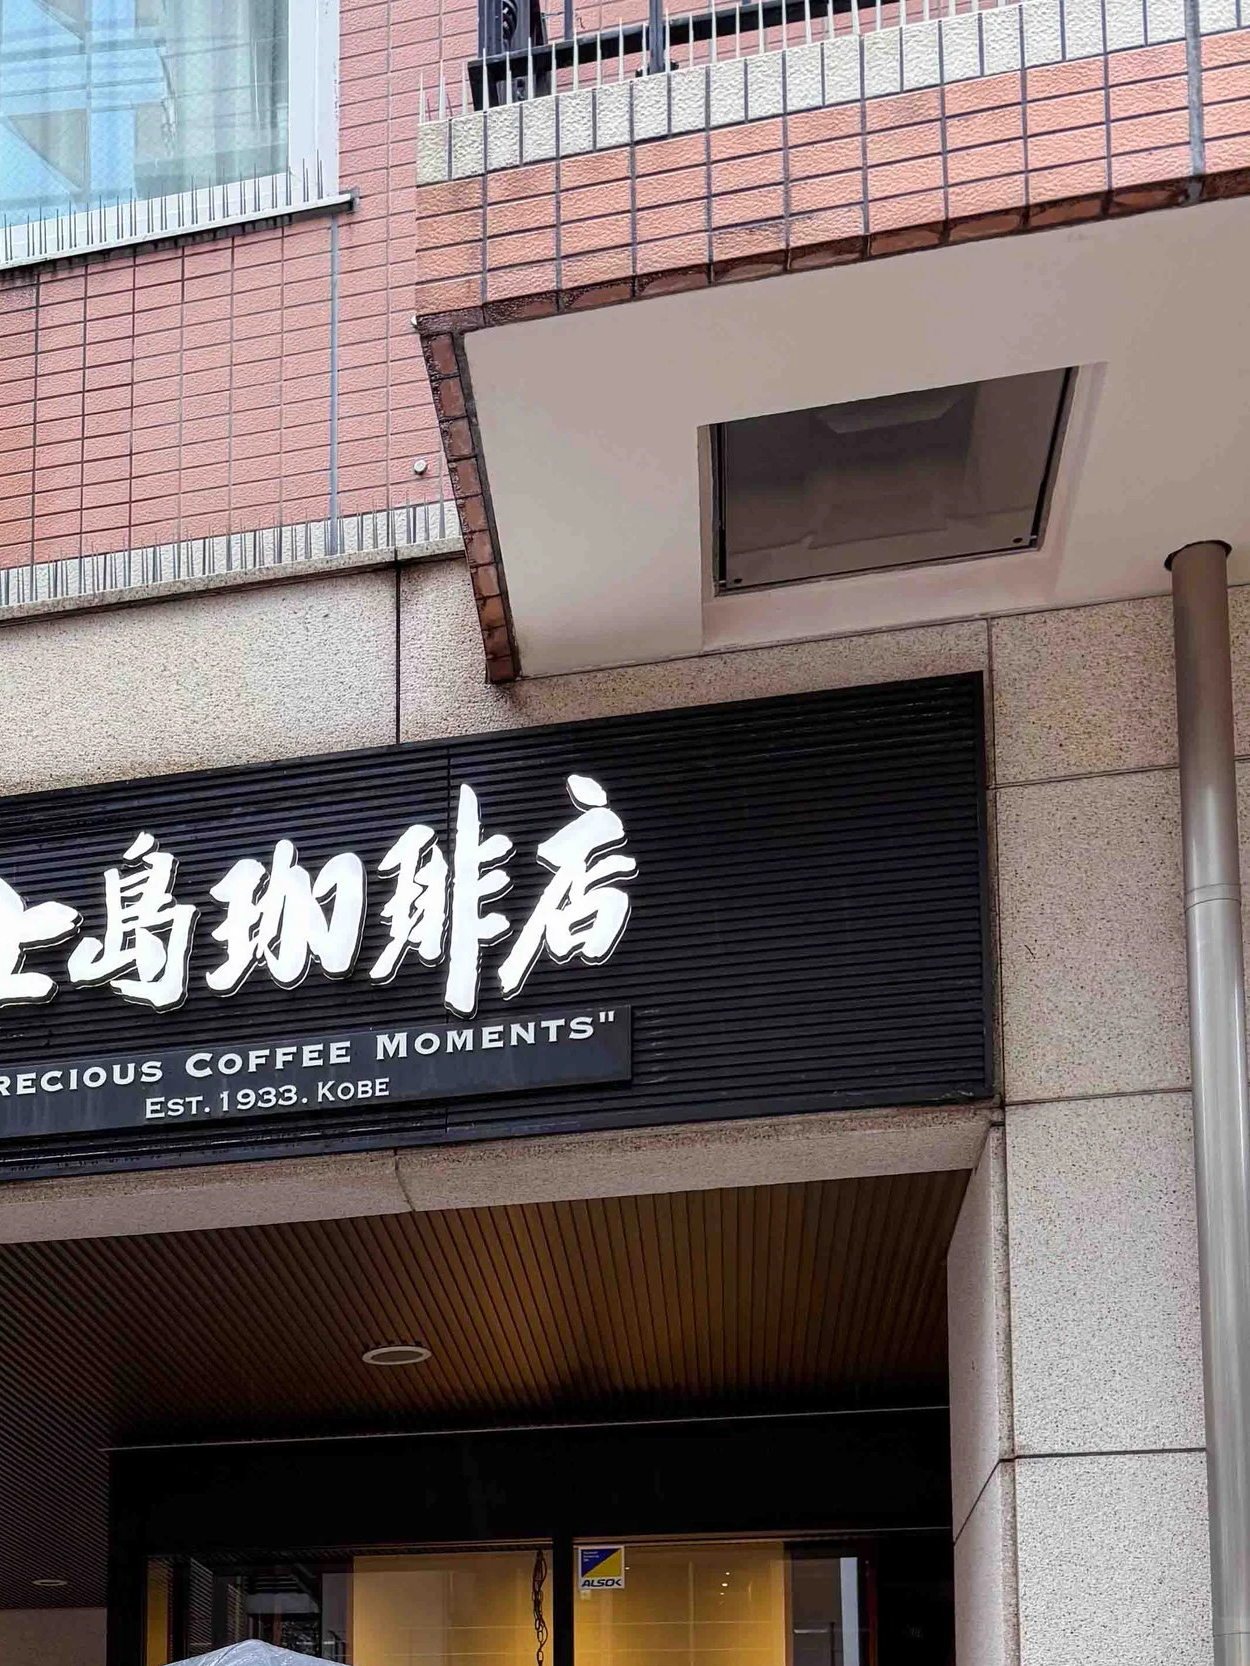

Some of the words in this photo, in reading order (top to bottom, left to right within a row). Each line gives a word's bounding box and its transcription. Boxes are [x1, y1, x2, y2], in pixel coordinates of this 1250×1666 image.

[185, 1040, 352, 1079] COFFEE
[375, 1011, 616, 1061] MOMENTS"
[144, 1094, 211, 1120] EST.
[219, 1086, 308, 1115] 1933.
[316, 1077, 391, 1103] KOBE
[581, 1579, 622, 1587] ALSOK
